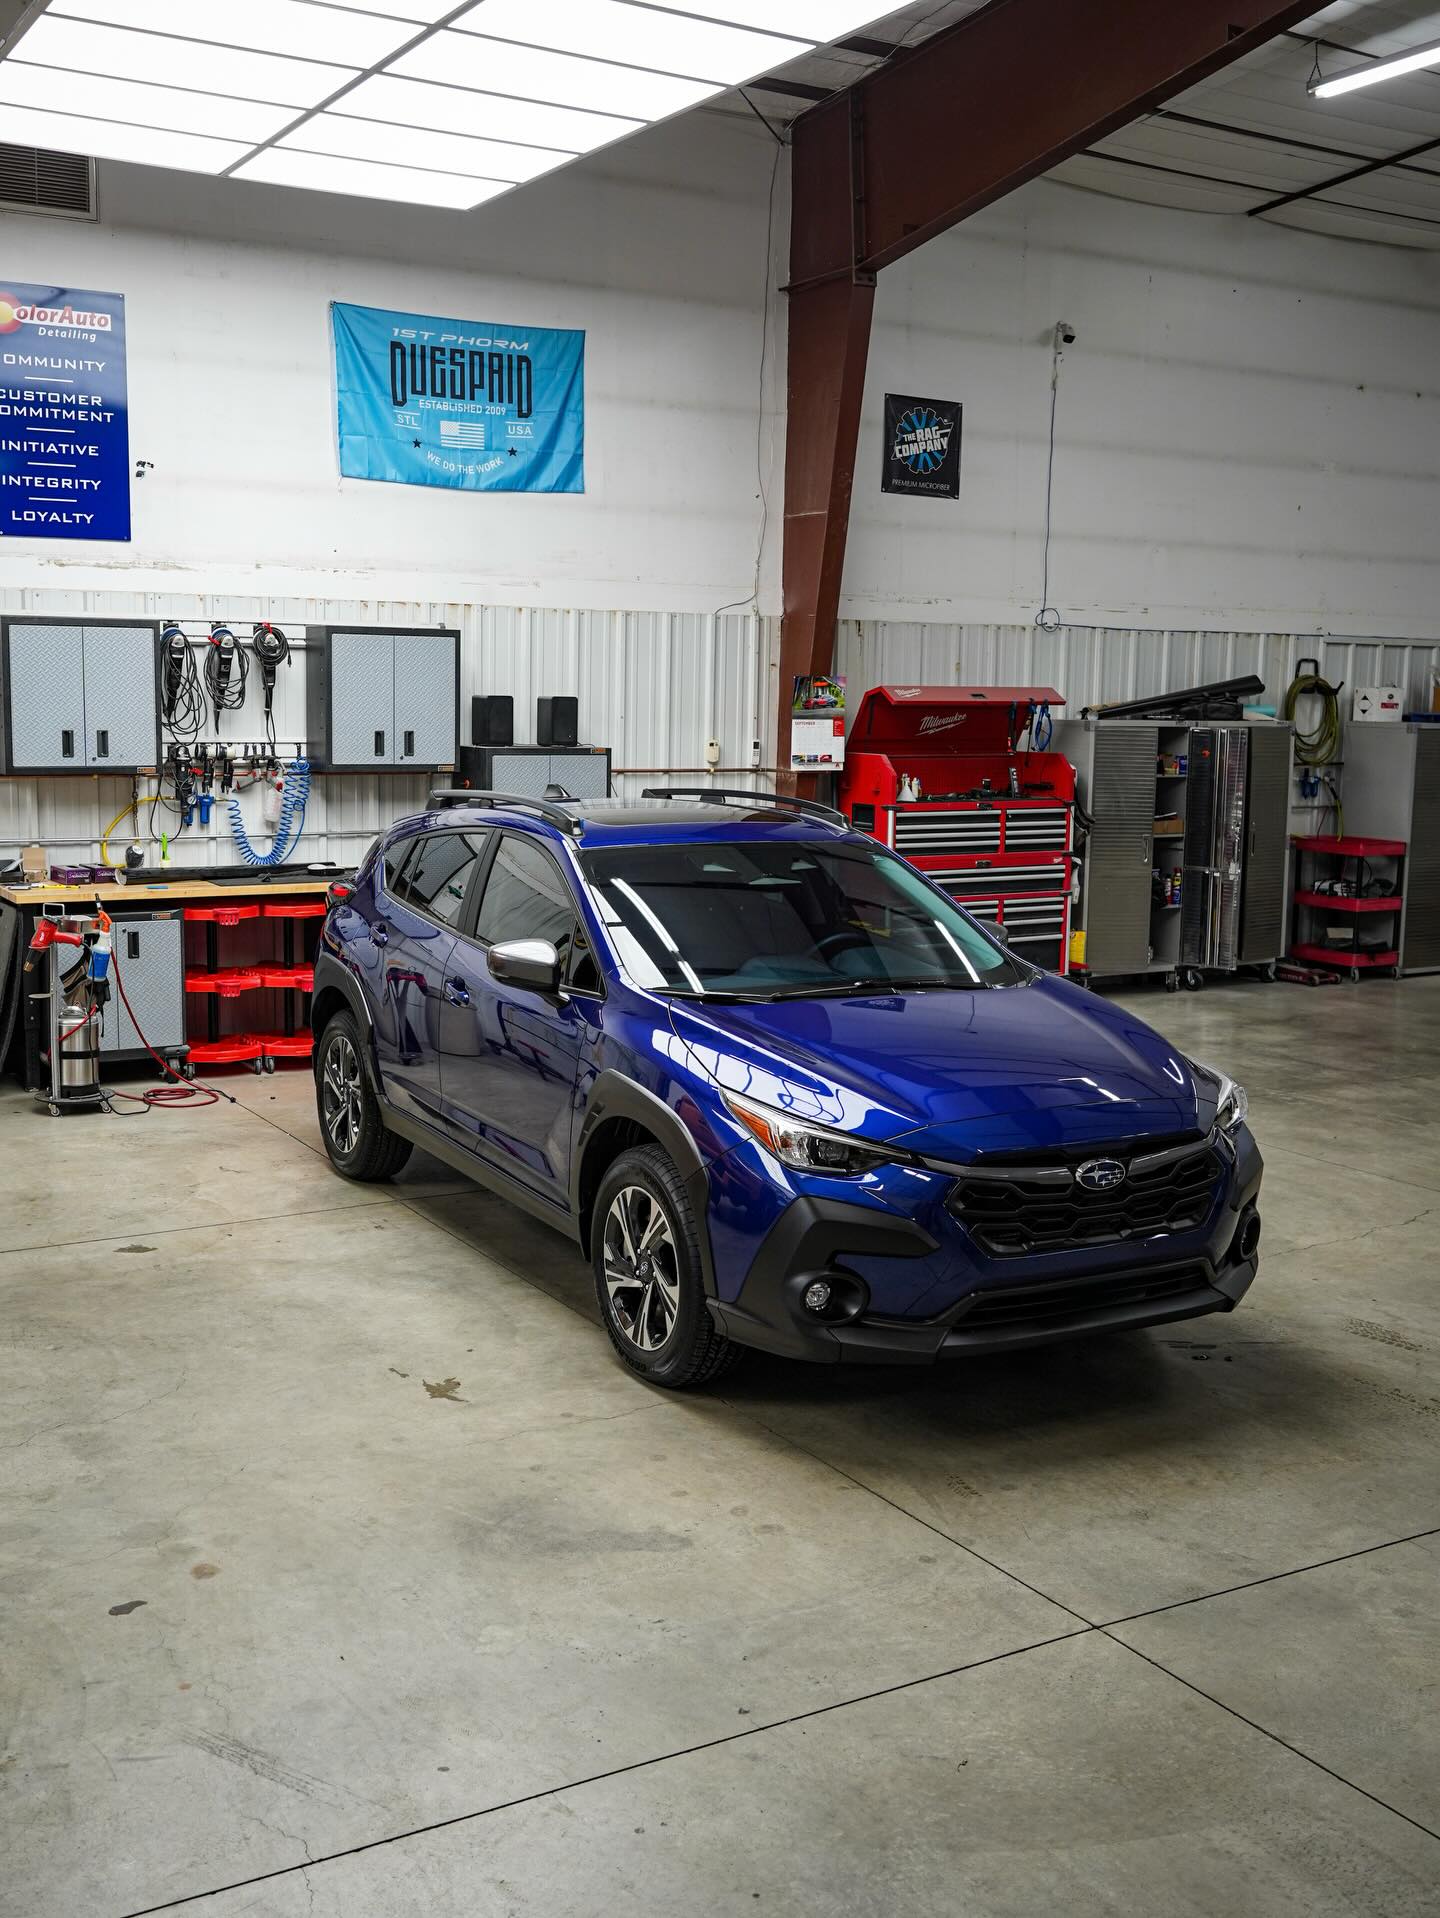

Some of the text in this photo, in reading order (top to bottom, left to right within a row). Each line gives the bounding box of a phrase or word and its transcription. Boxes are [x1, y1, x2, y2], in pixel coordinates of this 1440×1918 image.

[38, 326, 97, 343] Detailing
[392, 327, 530, 351] 1ST PHORM
[3, 353, 107, 373] OMMUNITY
[0, 404, 115, 423] OMMITMENT
[419, 400, 506, 416] ESTABLISHED 2009
[397, 414, 418, 426] STL
[508, 425, 532, 435] USA
[903, 425, 952, 442] THE RAG
[1, 439, 100, 457] INITIATIVE
[895, 436, 948, 459] COMPANY
[427, 450, 504, 475] WE DO THE WORK
[1, 474, 102, 491] INTEGRITY
[11, 509, 95, 525] LOYALTY
[918, 712, 968, 732] Milwaukee
